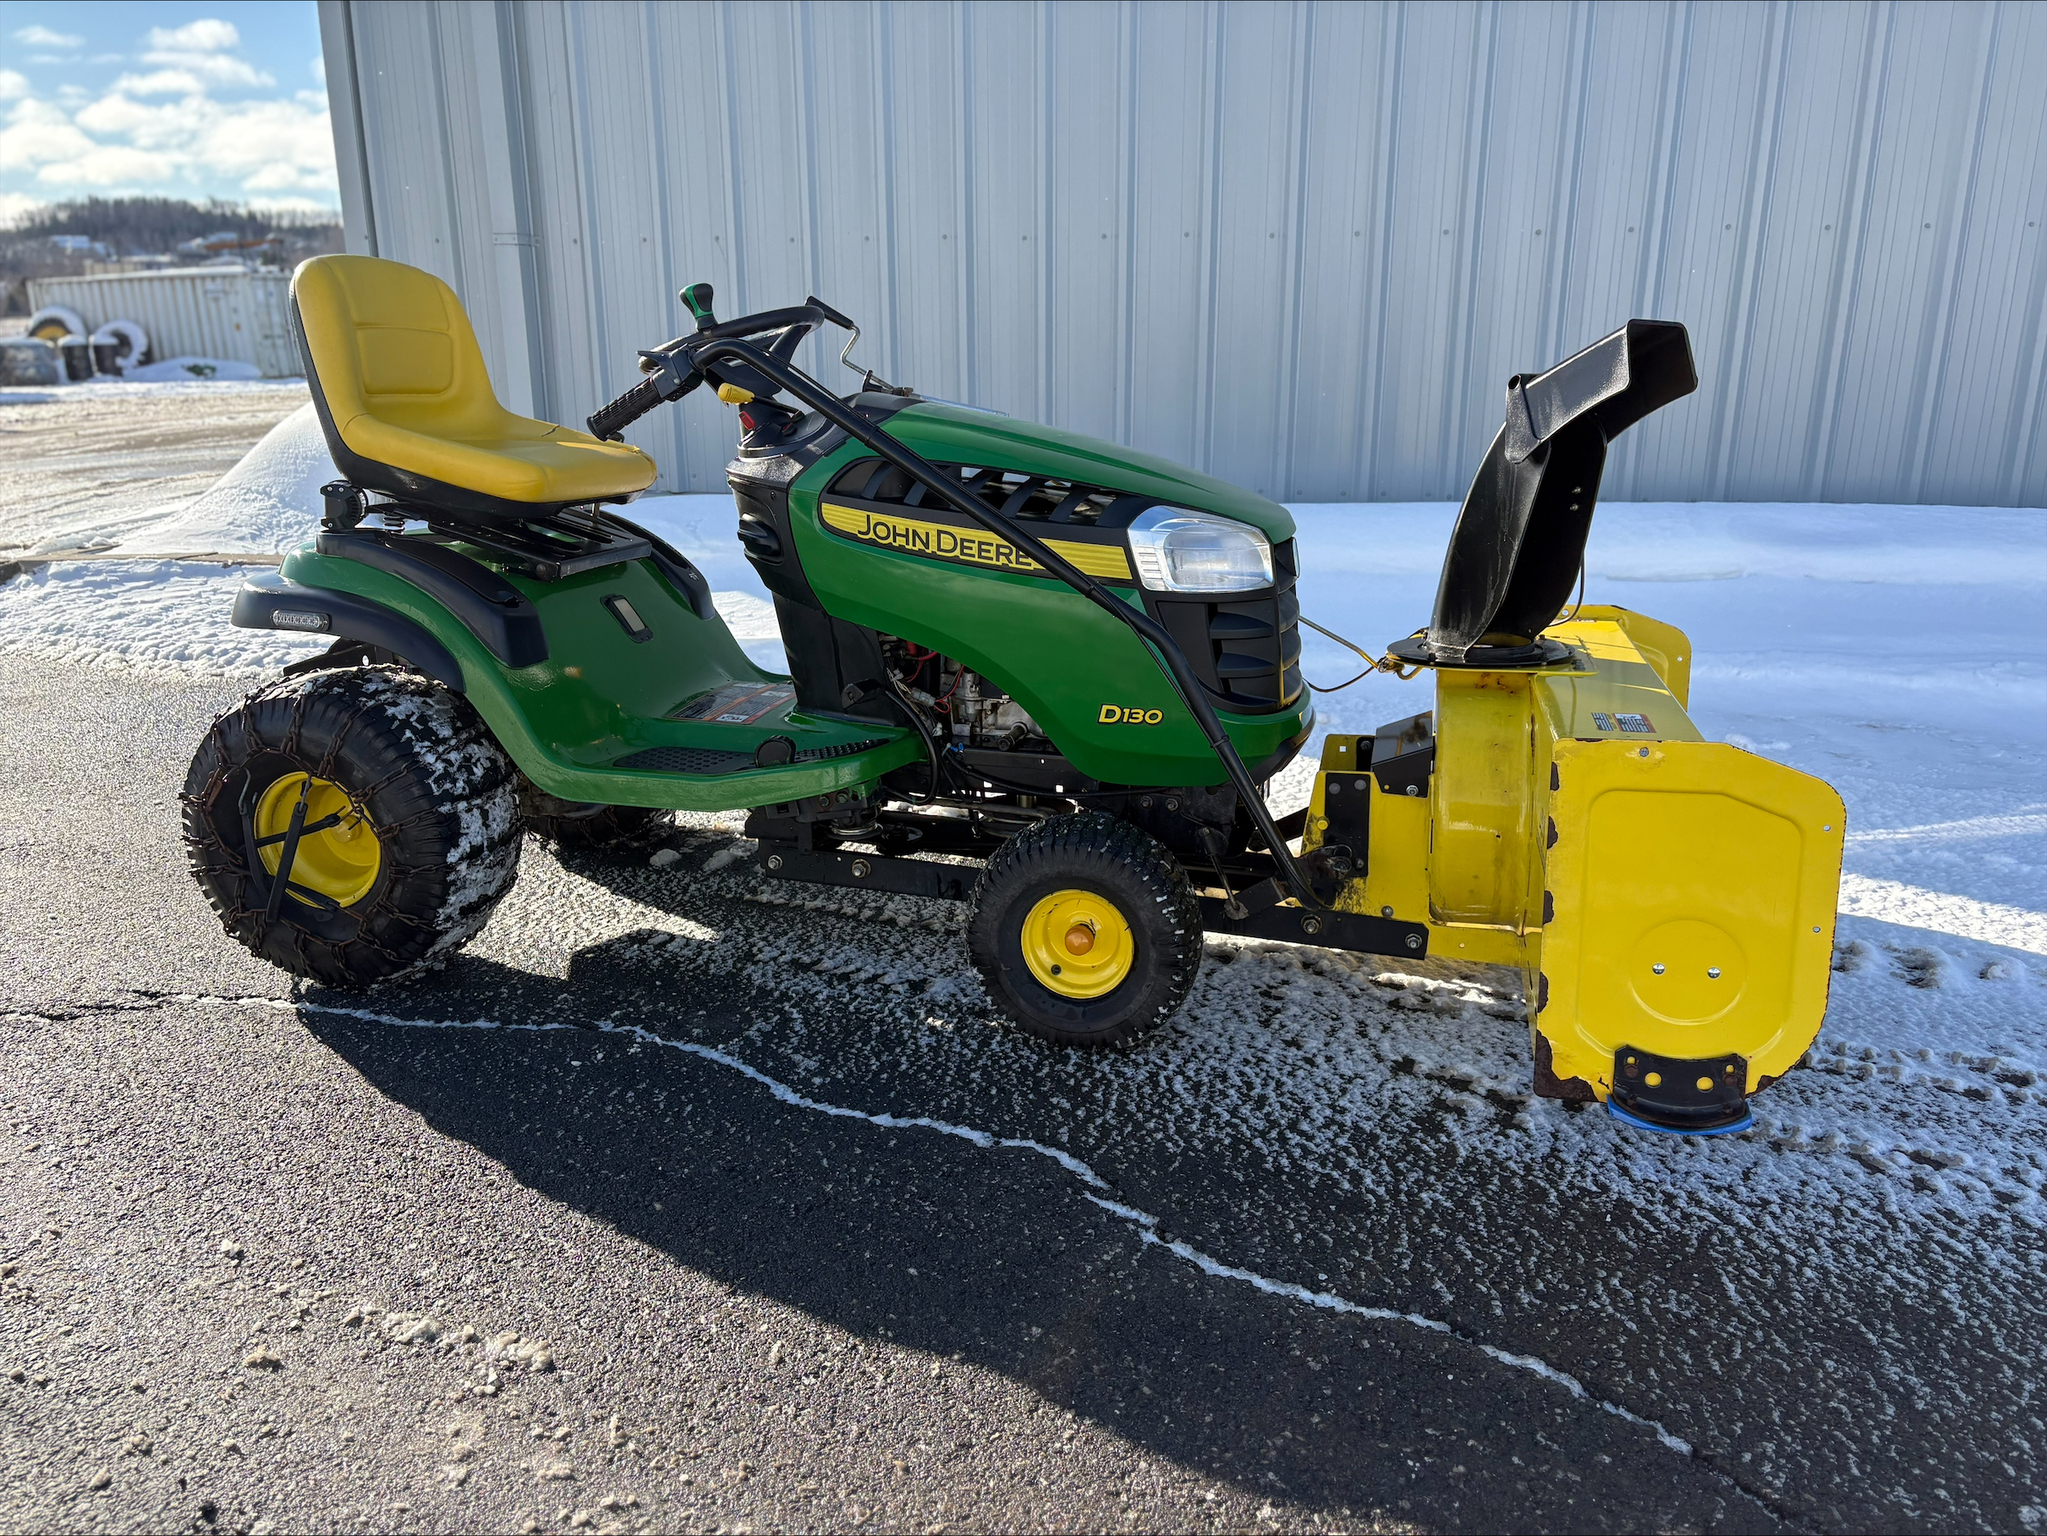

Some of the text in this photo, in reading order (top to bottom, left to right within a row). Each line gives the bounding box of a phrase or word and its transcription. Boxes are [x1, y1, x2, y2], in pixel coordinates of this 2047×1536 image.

[858, 514, 1032, 567] JOHN DEERE
[1098, 704, 1163, 725] D130
